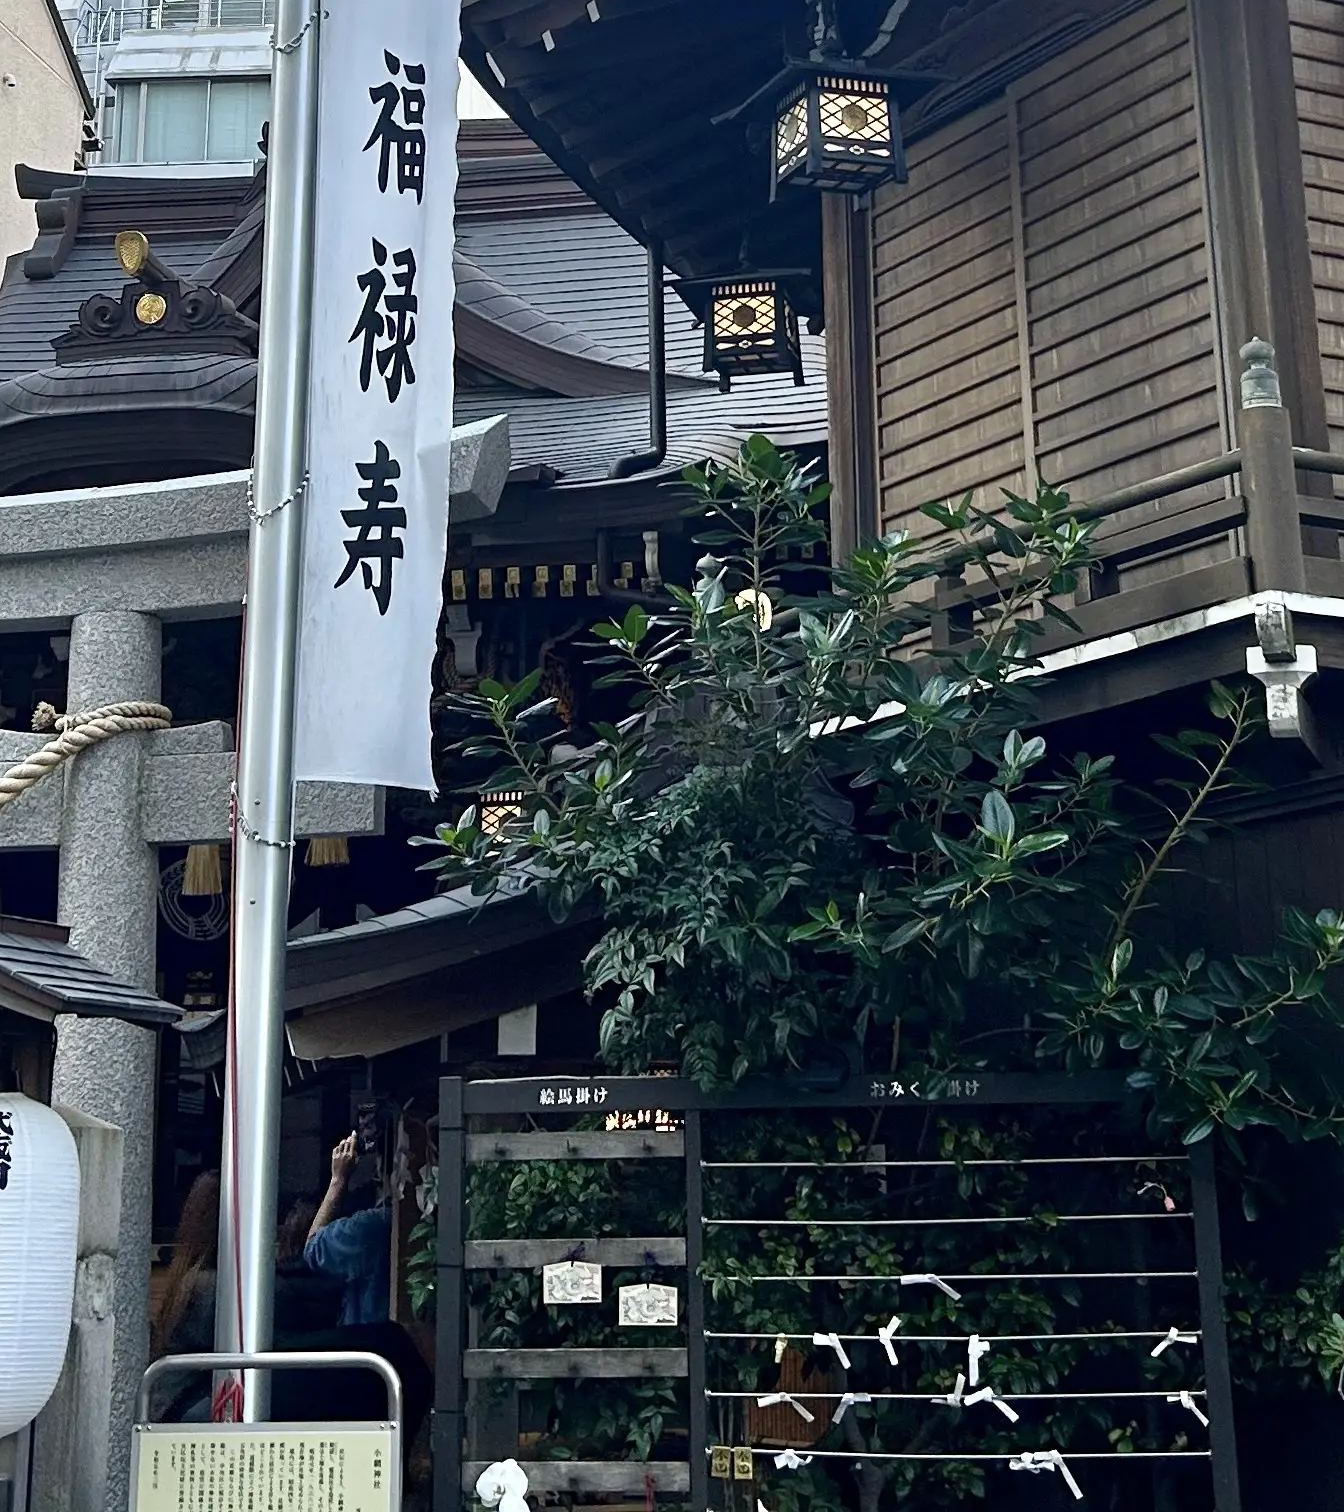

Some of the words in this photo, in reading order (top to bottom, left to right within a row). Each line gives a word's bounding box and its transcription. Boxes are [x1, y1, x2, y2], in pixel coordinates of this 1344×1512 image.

[334, 49, 427, 617] 福禄寿
[539, 1086, 609, 1105] 絵馬掛け
[869, 1079, 981, 1098] おみく掛け
